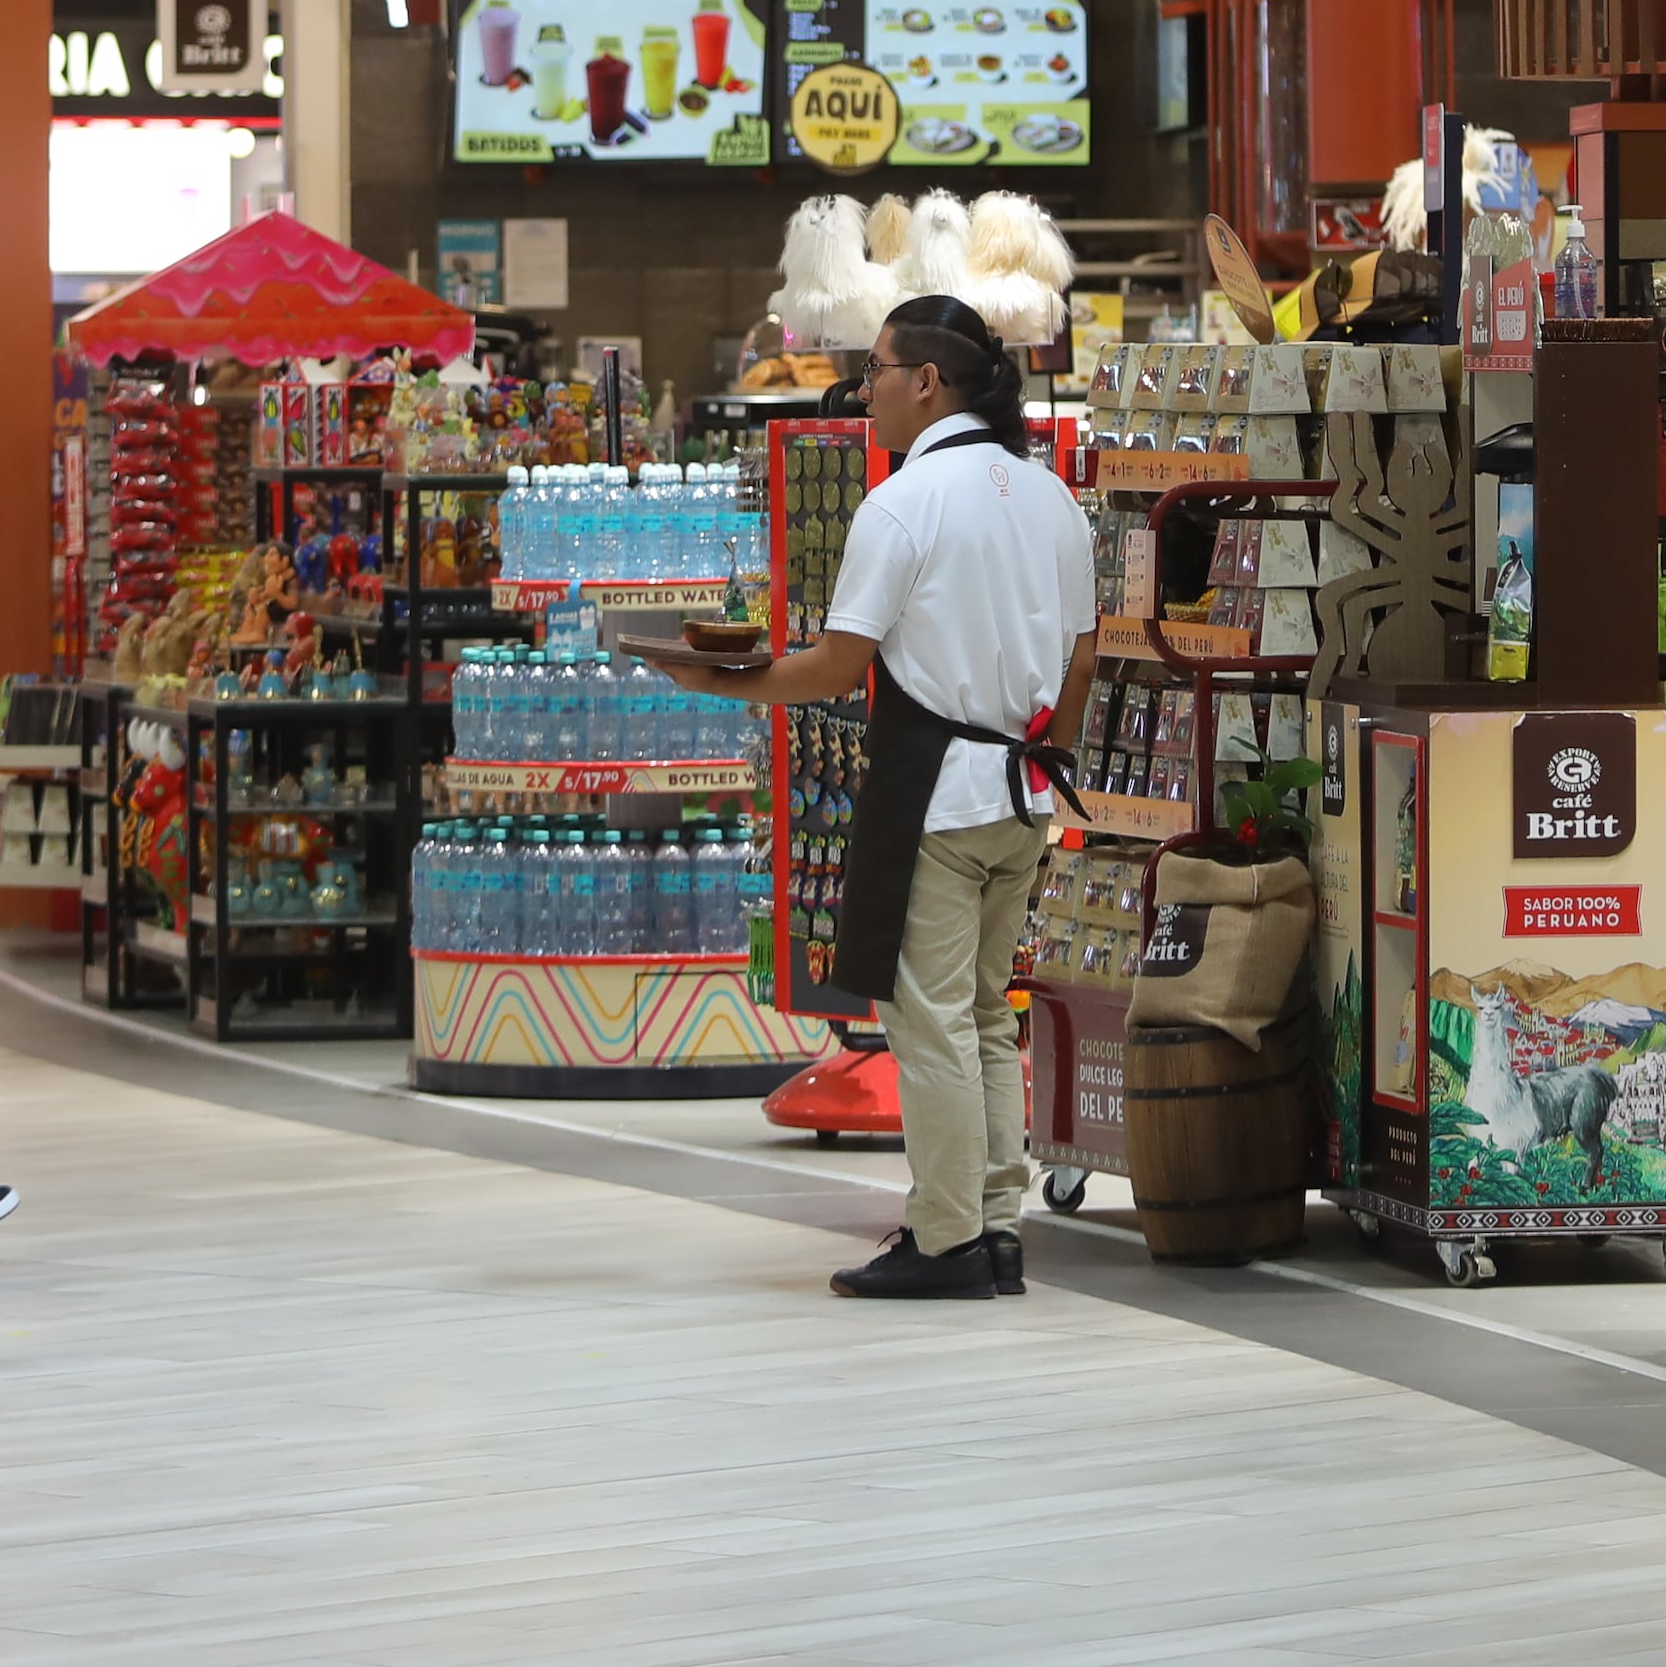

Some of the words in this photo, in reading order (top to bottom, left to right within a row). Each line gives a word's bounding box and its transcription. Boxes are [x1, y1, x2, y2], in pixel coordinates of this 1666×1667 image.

[183, 43, 243, 65] Britt
[804, 85, 882, 121] AQUÍ
[1507, 280, 1524, 306] PERÚ
[1472, 323, 1488, 343] Britt
[602, 590, 675, 605] BOTTLED
[682, 588, 725, 604] WATE
[1178, 638, 1191, 651] DEL
[1195, 636, 1213, 653] PERÚ
[1552, 747, 1598, 764] EXPORT
[469, 772, 480, 784] DE
[483, 773, 514, 785] AGUA
[525, 773, 549, 788] 2X
[669, 772, 738, 786] BOTTLED
[1325, 774, 1343, 800] Britt
[1550, 773, 1601, 793] RESERVE
[1552, 793, 1593, 809] café
[1526, 810, 1620, 839] Britt
[1321, 895, 1339, 920] PERÚ
[1524, 898, 1573, 911] SABOR
[1577, 897, 1621, 911] 100%
[1524, 912, 1620, 927] PERUANO
[1155, 924, 1173, 936] afé
[1079, 1038, 1124, 1061] CHOCOTE
[1079, 1064, 1105, 1085] DULCE
[1108, 1068, 1123, 1087] LEG
[1080, 1092, 1104, 1120] DEL
[1108, 1095, 1124, 1123] PE
